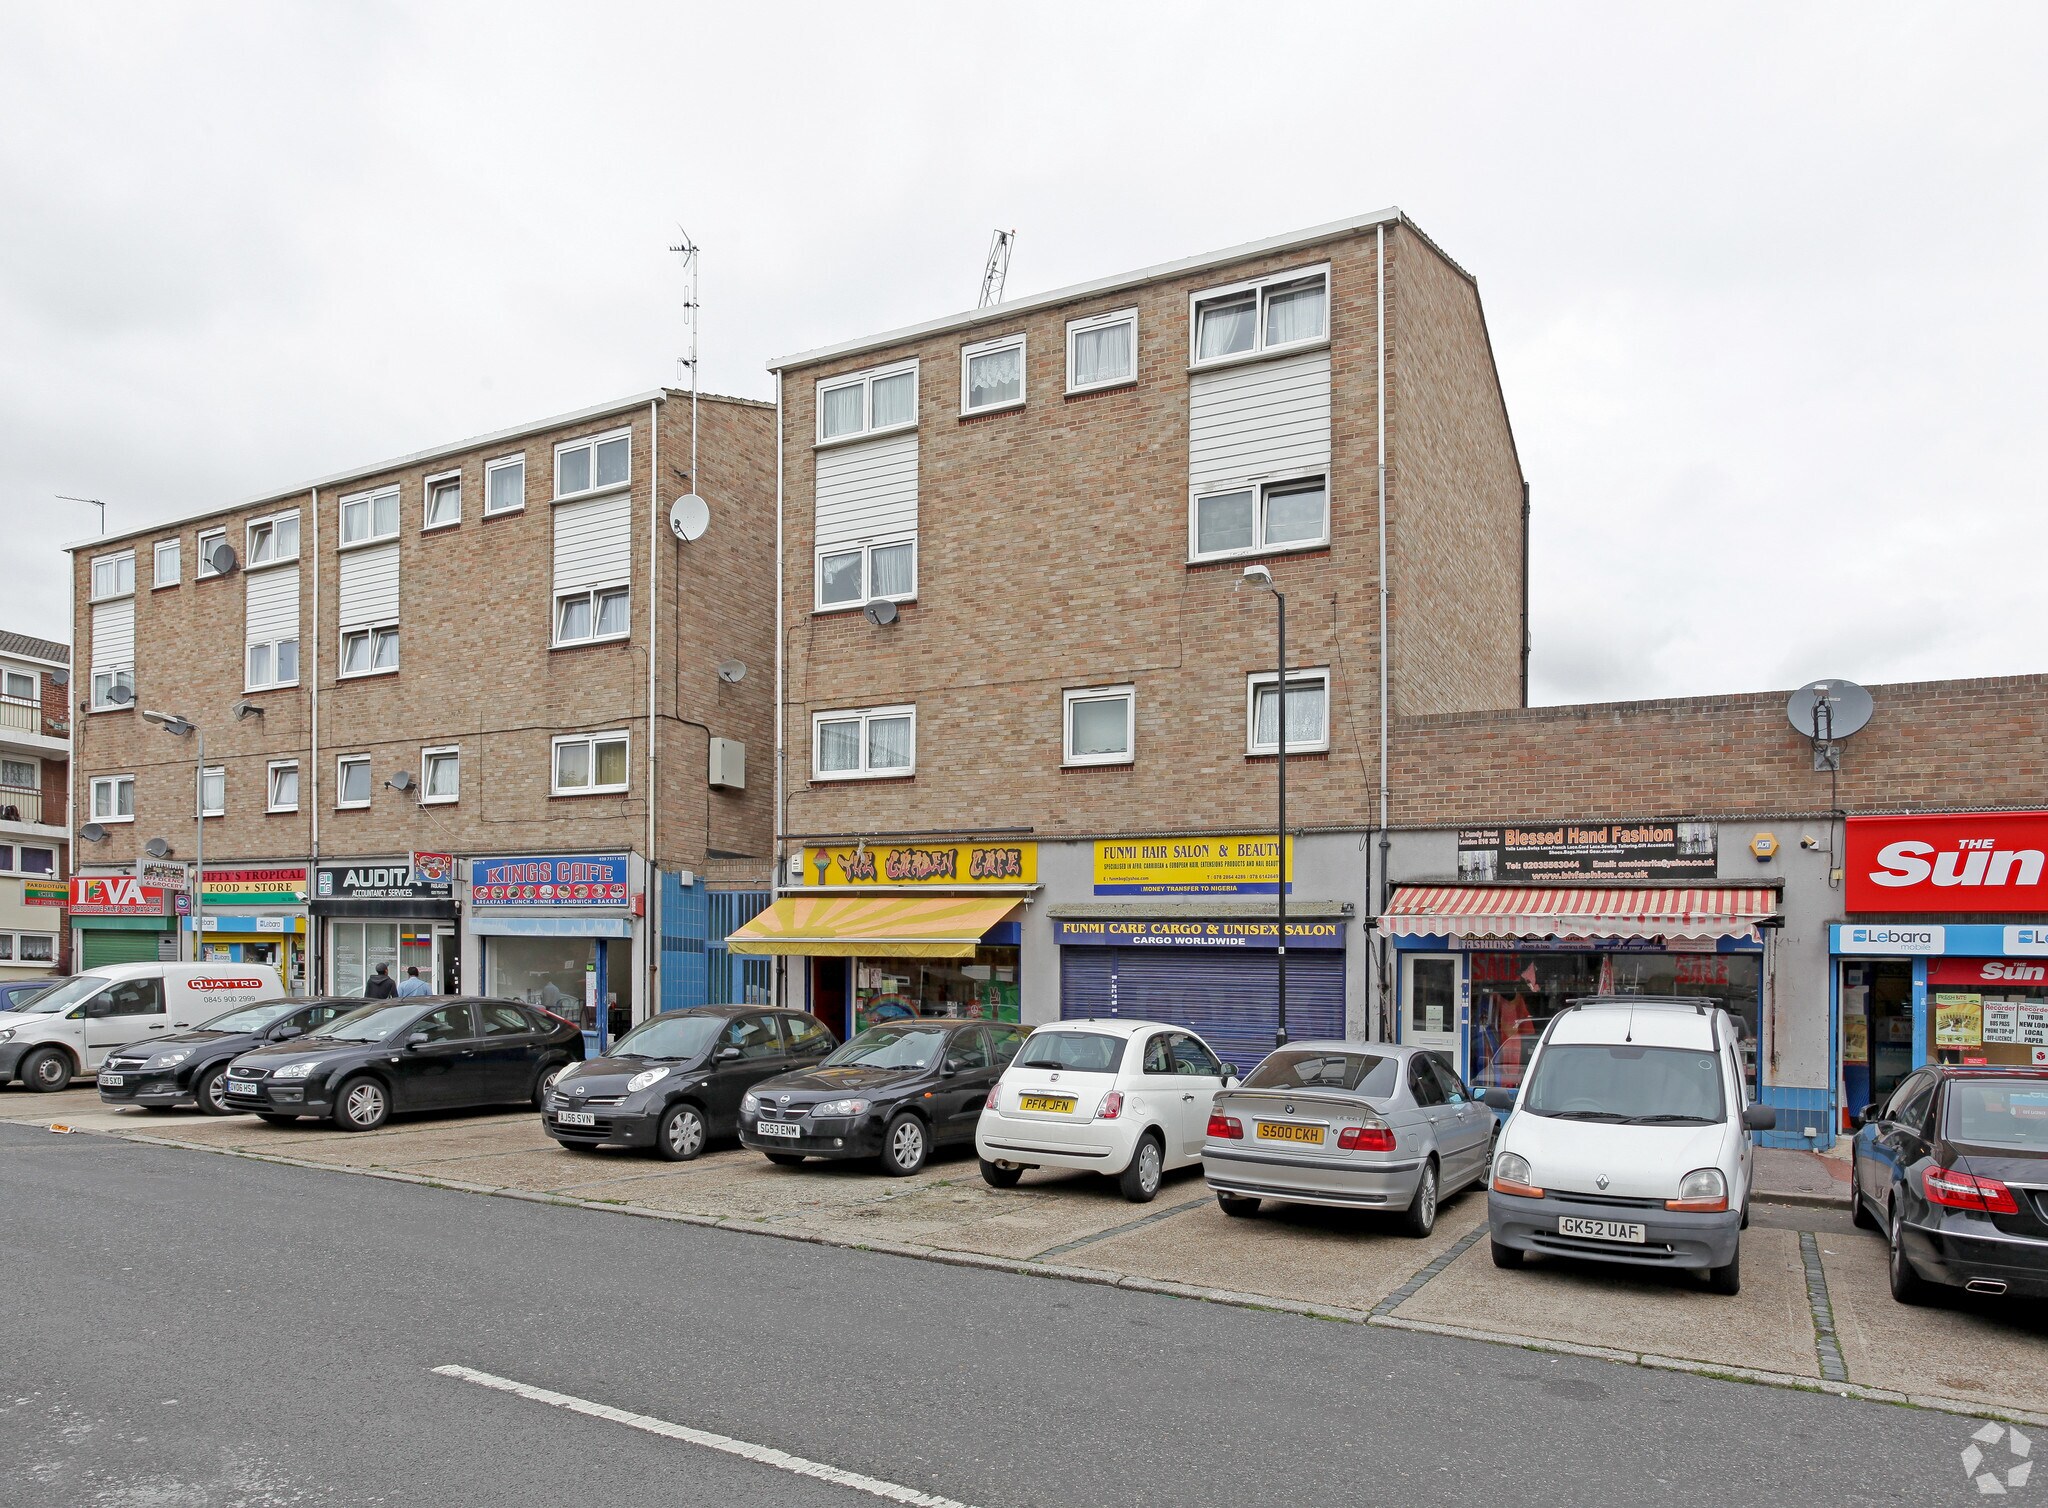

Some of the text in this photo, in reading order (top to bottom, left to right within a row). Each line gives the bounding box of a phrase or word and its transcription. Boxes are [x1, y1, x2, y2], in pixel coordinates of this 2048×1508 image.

[1504, 825, 1674, 846] Blessed Hand Fashion
[1958, 838, 1995, 849] THE
[1103, 843, 1280, 859] FUNMI HAIR SALON & BEAUTY
[1200, 860, 1223, 868] EXTENSIONS
[1592, 860, 1617, 868] Email:
[1868, 840, 2046, 887] Sun
[244, 869, 304, 881] TROPICAL
[485, 861, 613, 885] KINGS CAFE
[77, 879, 147, 905] IEVA
[209, 882, 293, 892] FOOD STORE
[351, 888, 413, 898] ACCOUNTANCY SERVICES
[1062, 923, 1336, 936] FUNMI CARE CARGO & UNISEX SALON
[1133, 936, 1246, 945] CARGO WORLDWIDE
[1868, 929, 1931, 944] Lebara
[1461, 939, 1515, 949] FASHIONS
[1471, 952, 1521, 981] SALE
[1675, 954, 1728, 984] SALE
[1979, 962, 2046, 981] Sun
[190, 980, 260, 989] QUATTRO
[223, 995, 237, 1003] 900
[1985, 1004, 2016, 1012] Recorder
[2019, 1005, 2048, 1013] Recorde
[2024, 1036, 2044, 1044] PAPER
[1025, 1098, 1070, 1111] PF14 JFN
[760, 1123, 797, 1136] SG53 ENM
[1262, 1124, 1319, 1141] S500 CKH
[1564, 1218, 1639, 1239] GK52 UAF
